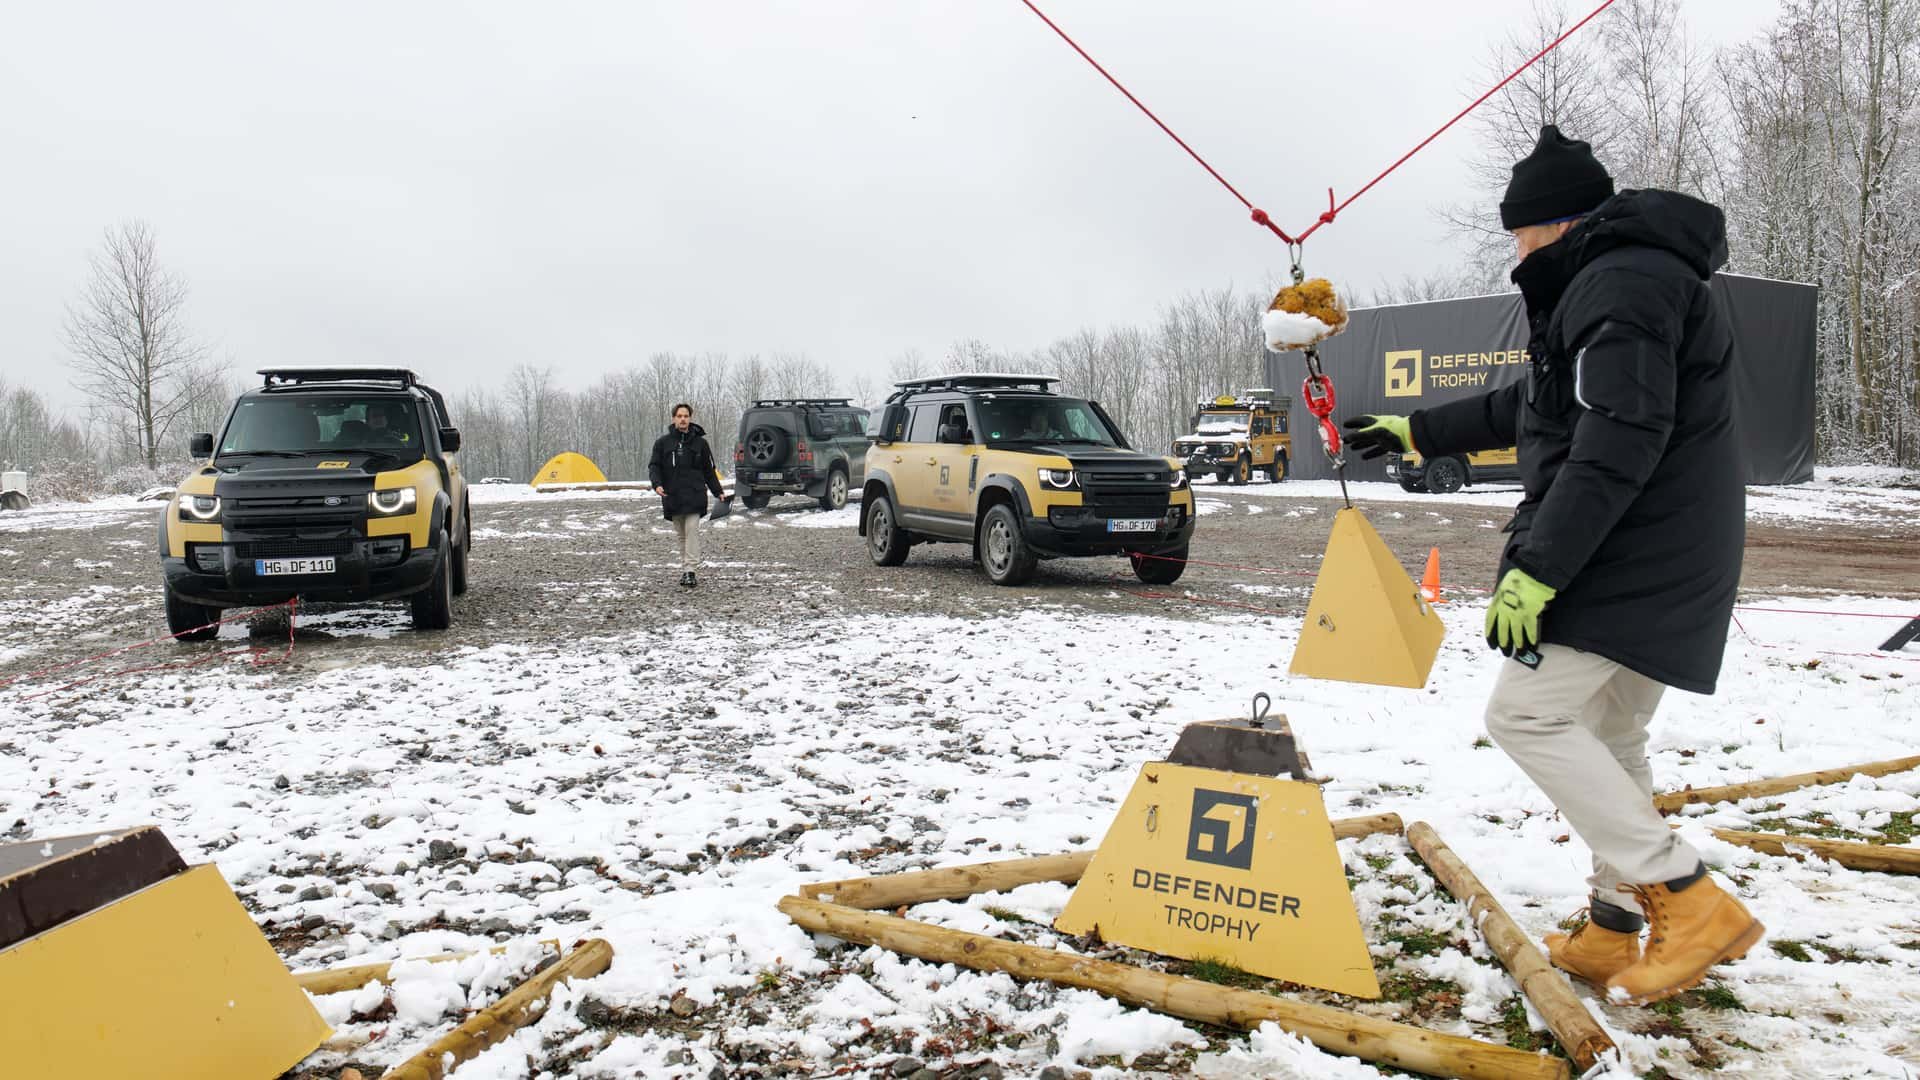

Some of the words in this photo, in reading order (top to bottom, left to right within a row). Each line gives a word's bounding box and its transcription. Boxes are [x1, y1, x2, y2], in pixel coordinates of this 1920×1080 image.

[1429, 371, 1488, 388] TROPHY
[1140, 520, 1156, 530] 170
[264, 561, 281, 573] HG
[290, 560, 306, 573] DF
[310, 559, 334, 572] 110
[1132, 868, 1301, 918] DEFENDER
[1164, 905, 1260, 942] TROPHY
